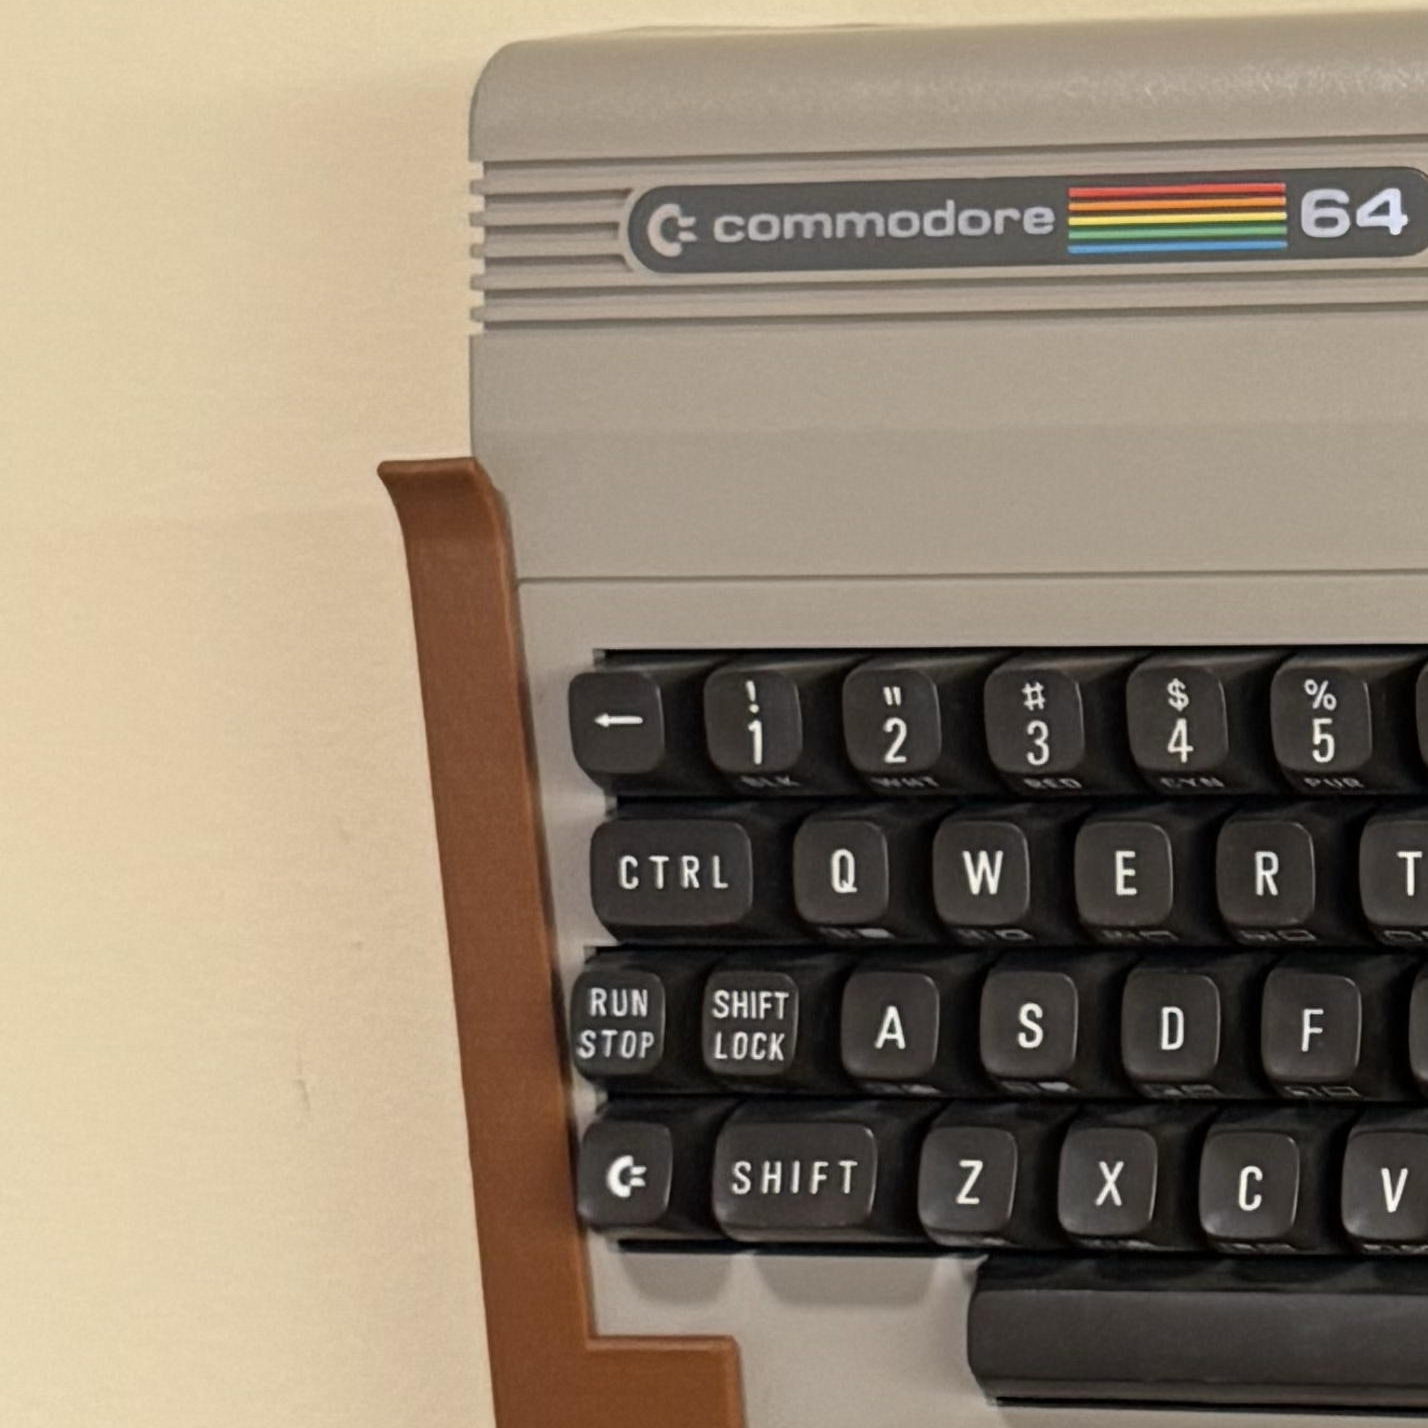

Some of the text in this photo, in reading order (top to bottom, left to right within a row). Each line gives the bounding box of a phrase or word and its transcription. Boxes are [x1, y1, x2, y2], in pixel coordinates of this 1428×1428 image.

[713, 187, 1409, 243] commodore 64
[745, 680, 760, 714] !
[883, 686, 902, 706] "
[1022, 681, 1046, 711] #
[1167, 678, 1189, 712] $
[1303, 679, 1337, 711] %
[748, 719, 763, 765] 1
[884, 717, 907, 764] 2
[1026, 720, 1050, 766] 3
[1167, 718, 1194, 763] 4
[1312, 717, 1335, 763] 5
[619, 855, 729, 890] CTRL
[831, 848, 858, 894] Q
[962, 850, 1004, 895] W
[1115, 850, 1138, 896] E
[1255, 851, 1279, 896] R
[1397, 851, 1423, 896] T
[589, 987, 648, 1017] RUN
[712, 989, 790, 1020] SHIFT
[576, 1029, 655, 1059] STOP
[714, 1031, 785, 1061] LOCK
[875, 1005, 906, 1050] A
[1017, 1002, 1044, 1049] S
[1160, 1006, 1185, 1051] D
[1301, 1008, 1324, 1052] F
[731, 1160, 858, 1195] SHIFT
[956, 1159, 983, 1205] Z
[1095, 1161, 1124, 1206] X
[1238, 1165, 1263, 1212] C
[1381, 1167, 1409, 1213] V
